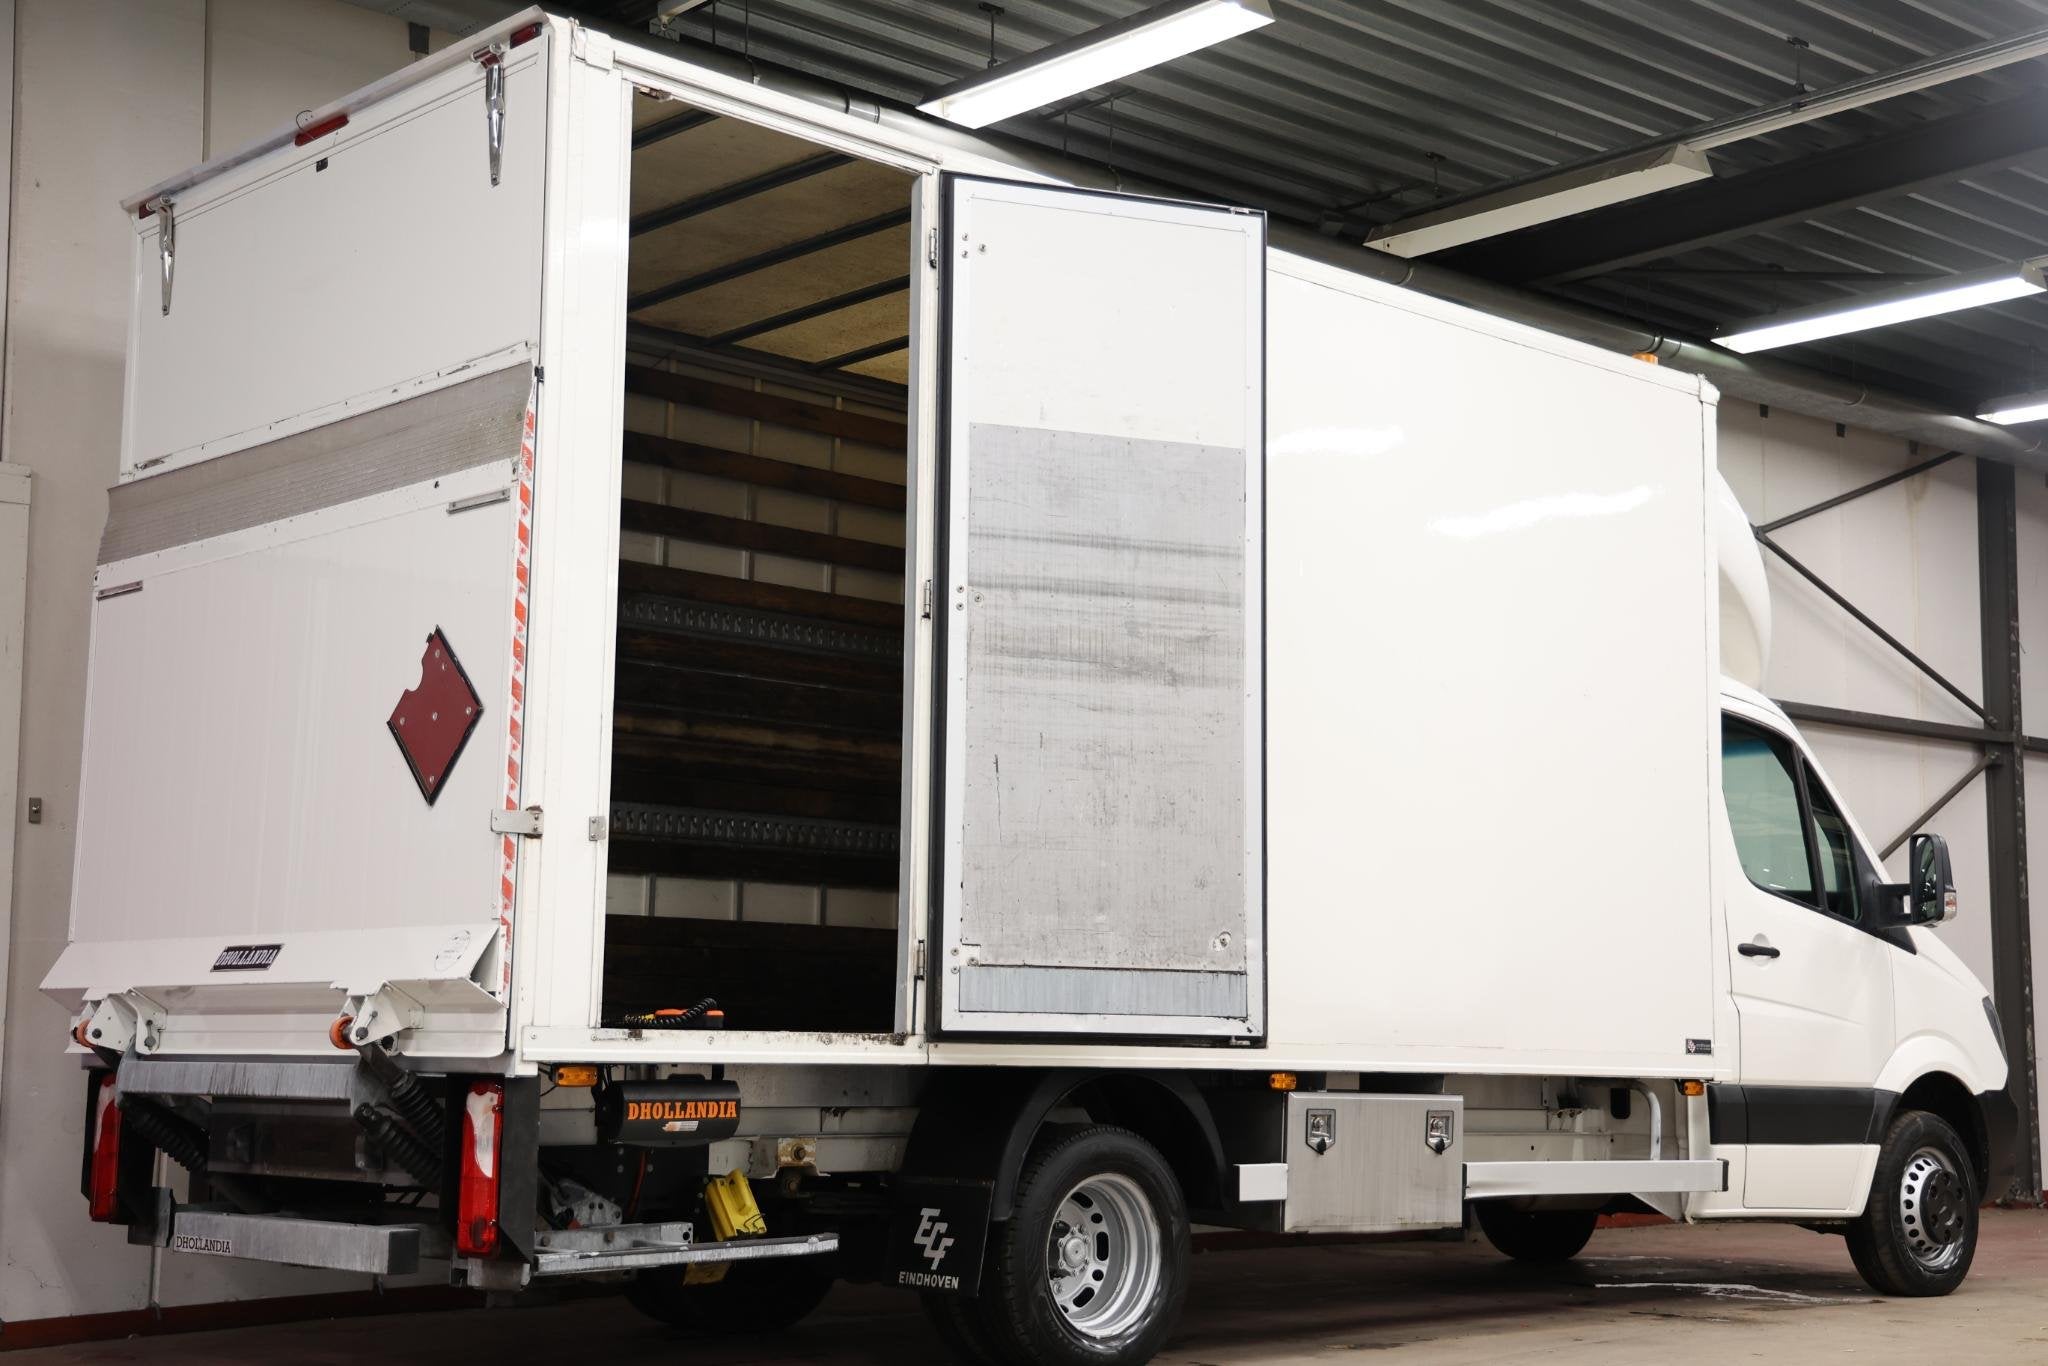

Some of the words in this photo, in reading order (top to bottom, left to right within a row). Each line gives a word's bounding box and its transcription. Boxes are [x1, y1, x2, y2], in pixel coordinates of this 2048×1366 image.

[215, 949, 278, 966] DHOLLANDIA
[627, 1101, 737, 1120] DHOLLANDIA
[176, 1236, 231, 1253] DHOLLANDIA
[899, 1271, 960, 1289] EINDHOVEN
